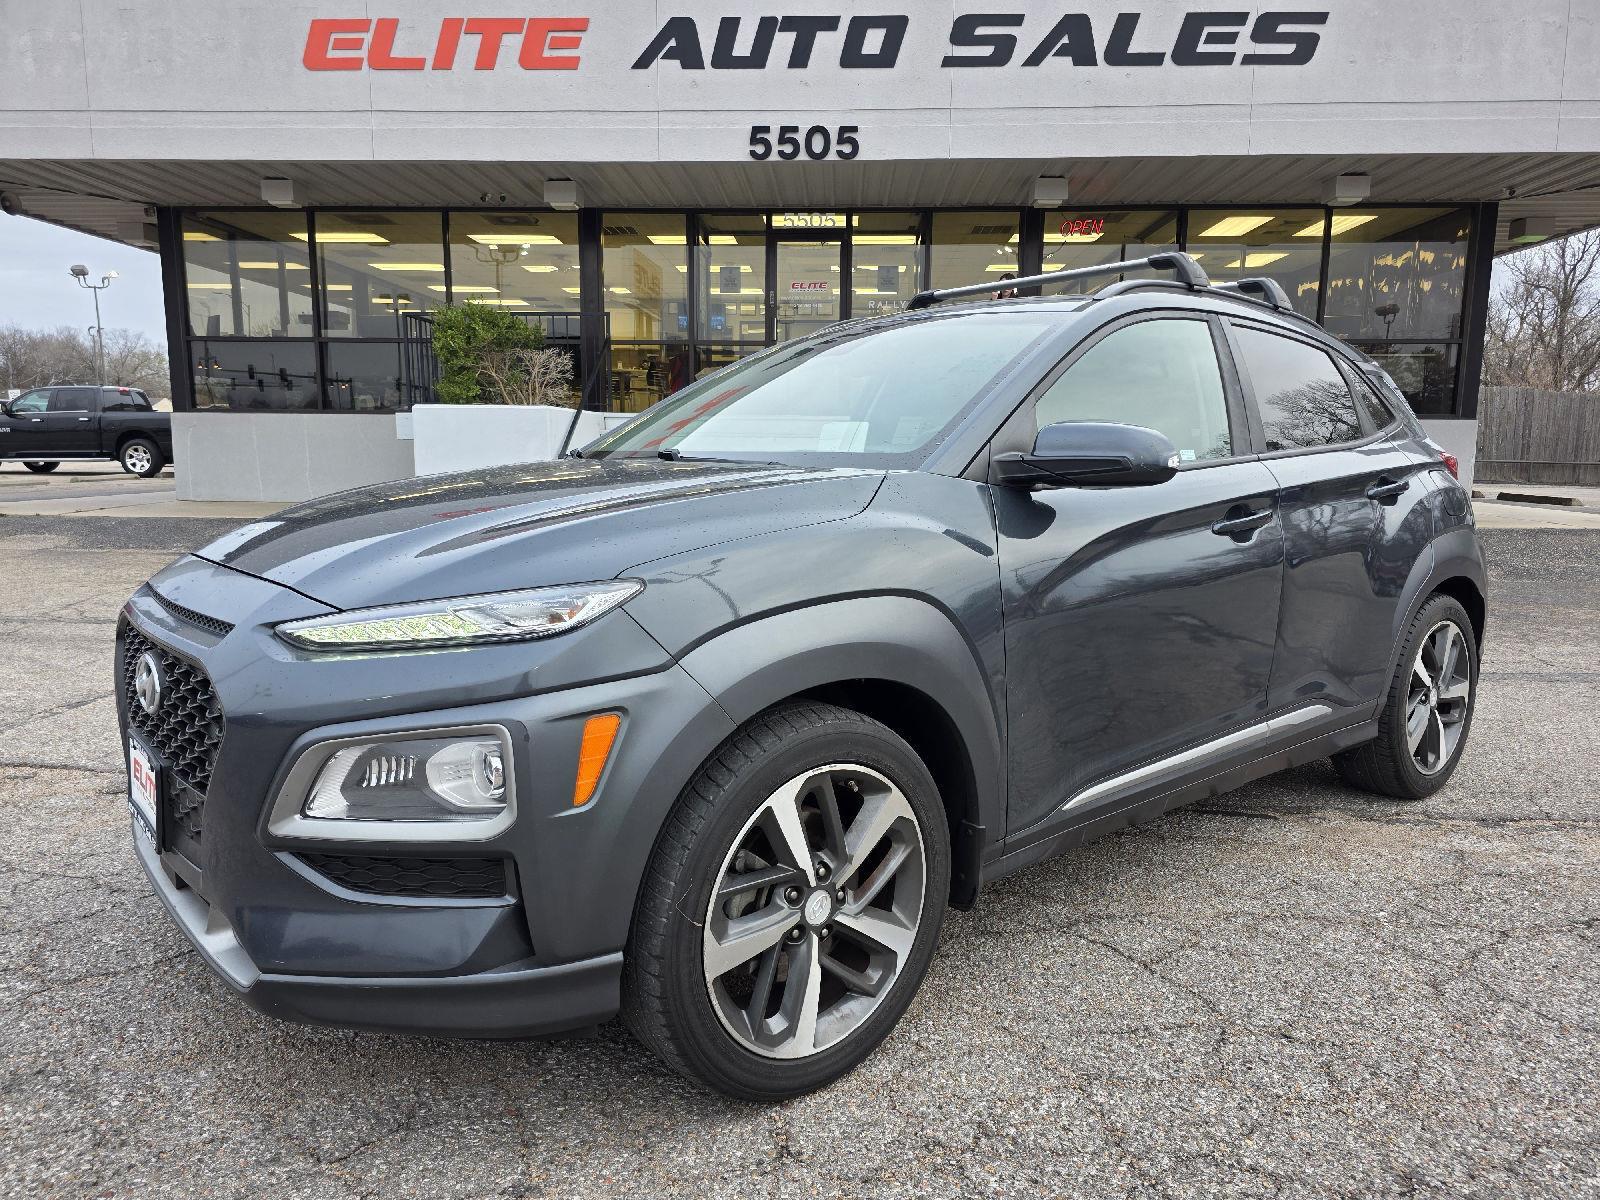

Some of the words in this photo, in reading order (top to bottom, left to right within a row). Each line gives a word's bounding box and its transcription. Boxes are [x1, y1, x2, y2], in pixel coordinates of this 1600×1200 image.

[303, 18, 589, 71] ELITE
[631, 15, 909, 69] AUTO
[941, 11, 1329, 68] SALES
[749, 125, 859, 161] 5505
[783, 212, 836, 229] 5505
[1061, 219, 1103, 236] OPEN
[791, 281, 828, 290] ELITE
[868, 300, 907, 309] RALLY
